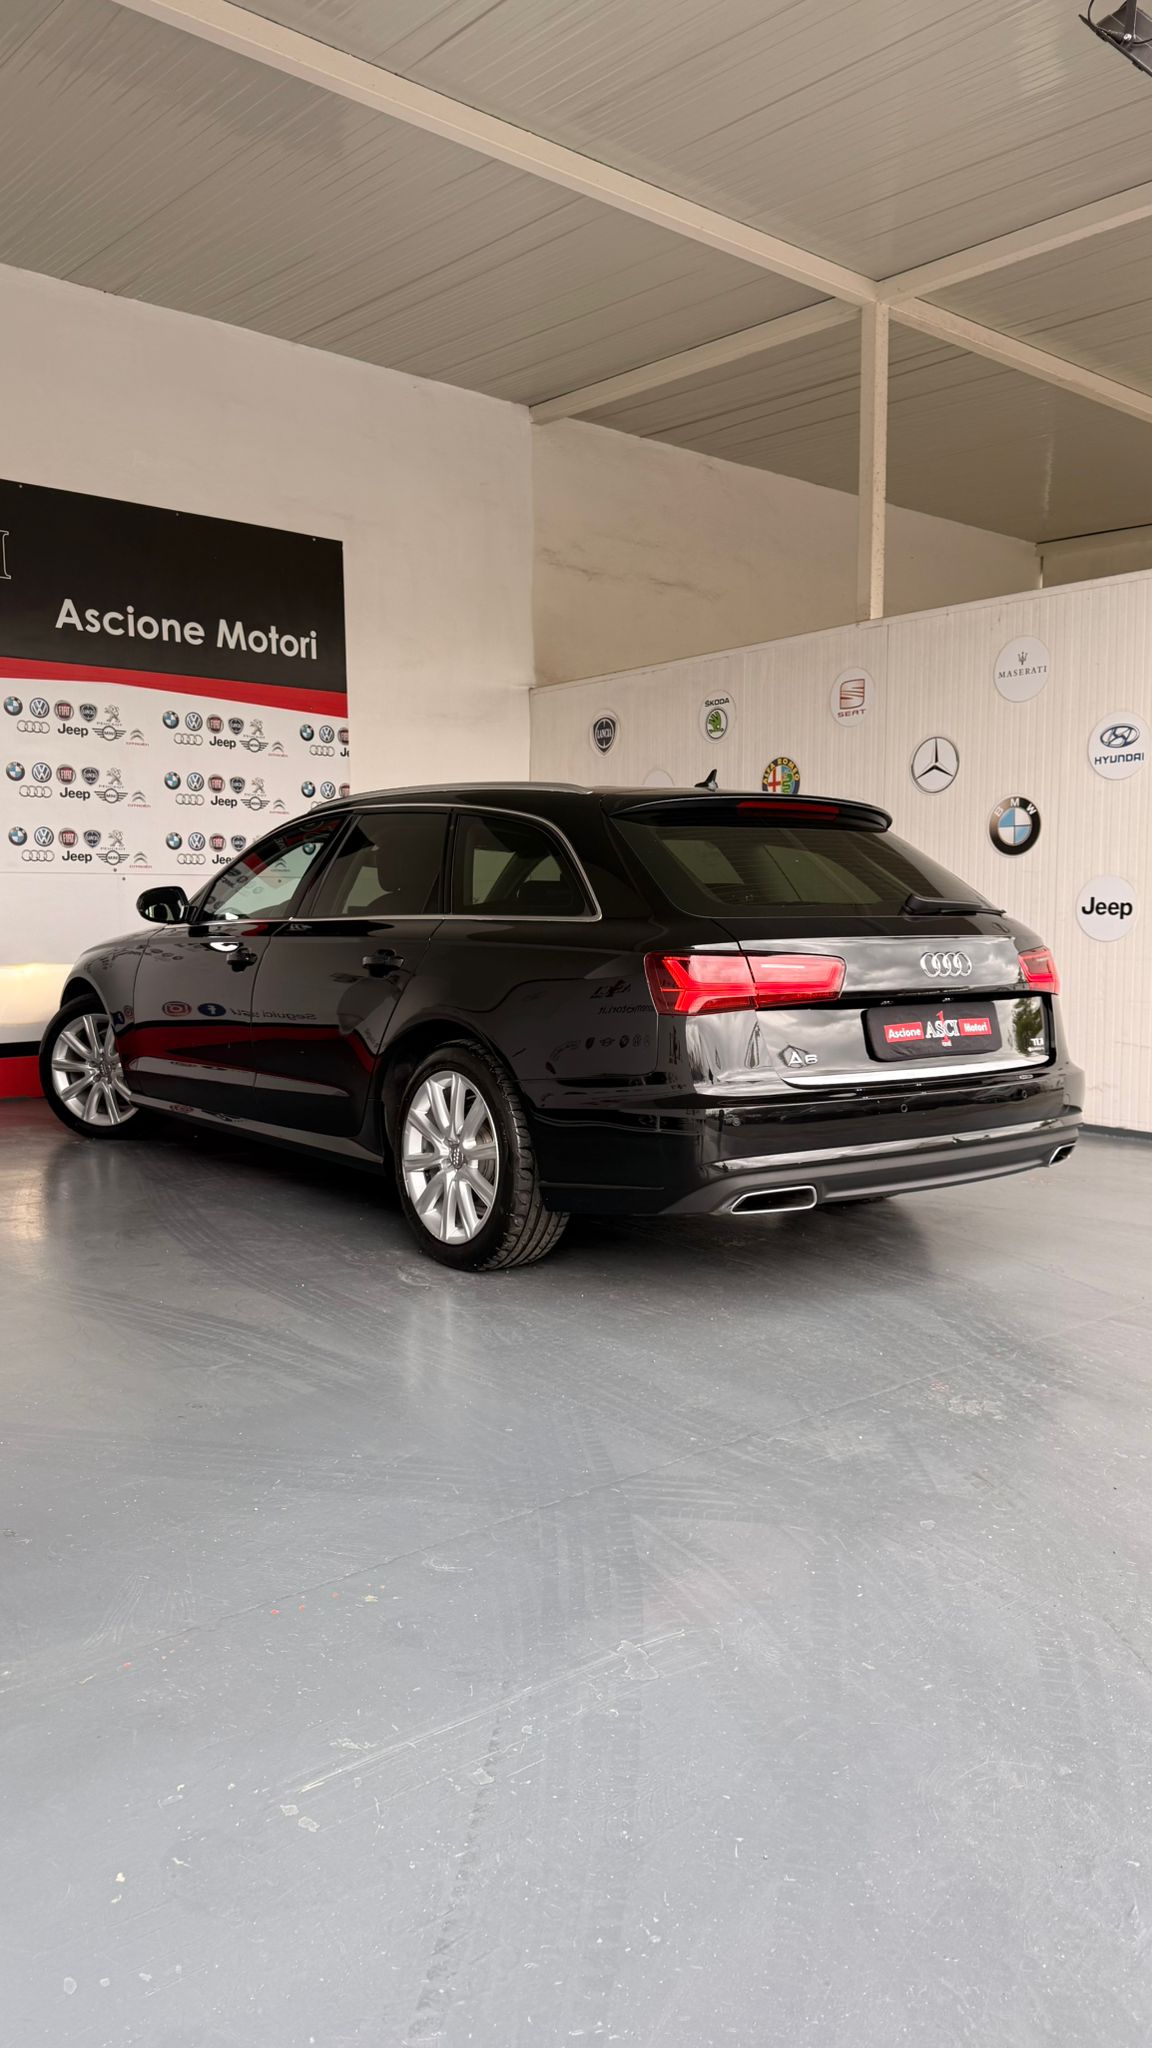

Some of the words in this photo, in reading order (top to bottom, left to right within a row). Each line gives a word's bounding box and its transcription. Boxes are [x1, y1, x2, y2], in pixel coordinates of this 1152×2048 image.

[55, 598, 205, 645] Ascione
[216, 618, 318, 660] Motori
[998, 665, 1047, 679] MASERATI
[837, 708, 866, 719] SEAT
[57, 723, 89, 738] Jeep
[209, 736, 236, 750] Jeep
[1094, 752, 1145, 766] HYUNDAI
[59, 787, 91, 801] Jeep
[210, 795, 238, 809] Jeep
[994, 797, 1037, 817] BMW
[61, 850, 93, 864] Jeep
[211, 854, 233, 865] Jee
[1081, 896, 1133, 920] Jeep
[888, 1026, 922, 1039] Ascione
[925, 1019, 961, 1039] ASCI
[963, 1022, 988, 1033] Motori
[788, 1051, 818, 1067] A6
